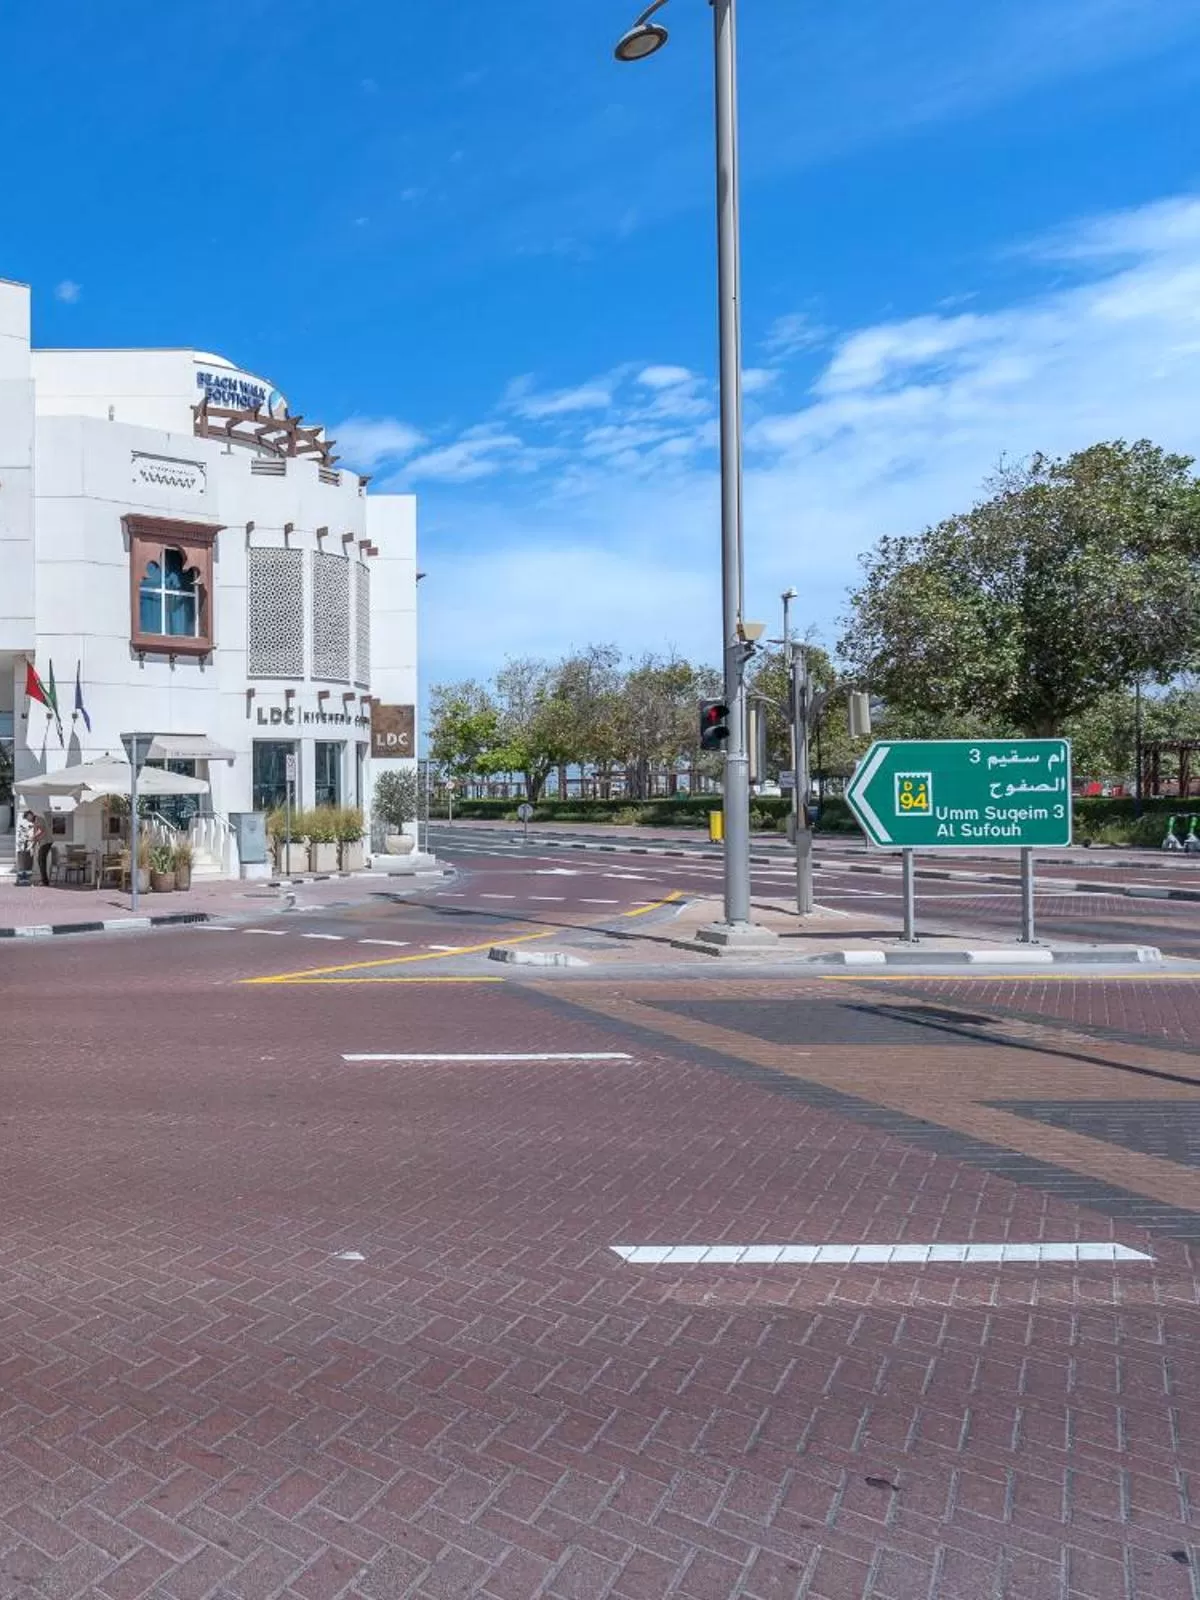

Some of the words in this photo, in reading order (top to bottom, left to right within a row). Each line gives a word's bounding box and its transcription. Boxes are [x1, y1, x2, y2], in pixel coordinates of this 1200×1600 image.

[196, 372, 237, 392] BEACH
[257, 706, 295, 726] LDC
[376, 732, 409, 747] LDC
[969, 748, 981, 764] 3
[987, 749, 1040, 771] سقيم
[989, 776, 1066, 799] الصفوح
[900, 792, 929, 809] 94
[936, 806, 979, 821] Umm
[985, 805, 1049, 824] Suqeim
[1053, 804, 1065, 819] 3
[936, 823, 956, 837] Al
[960, 823, 1022, 837] Sufouh
